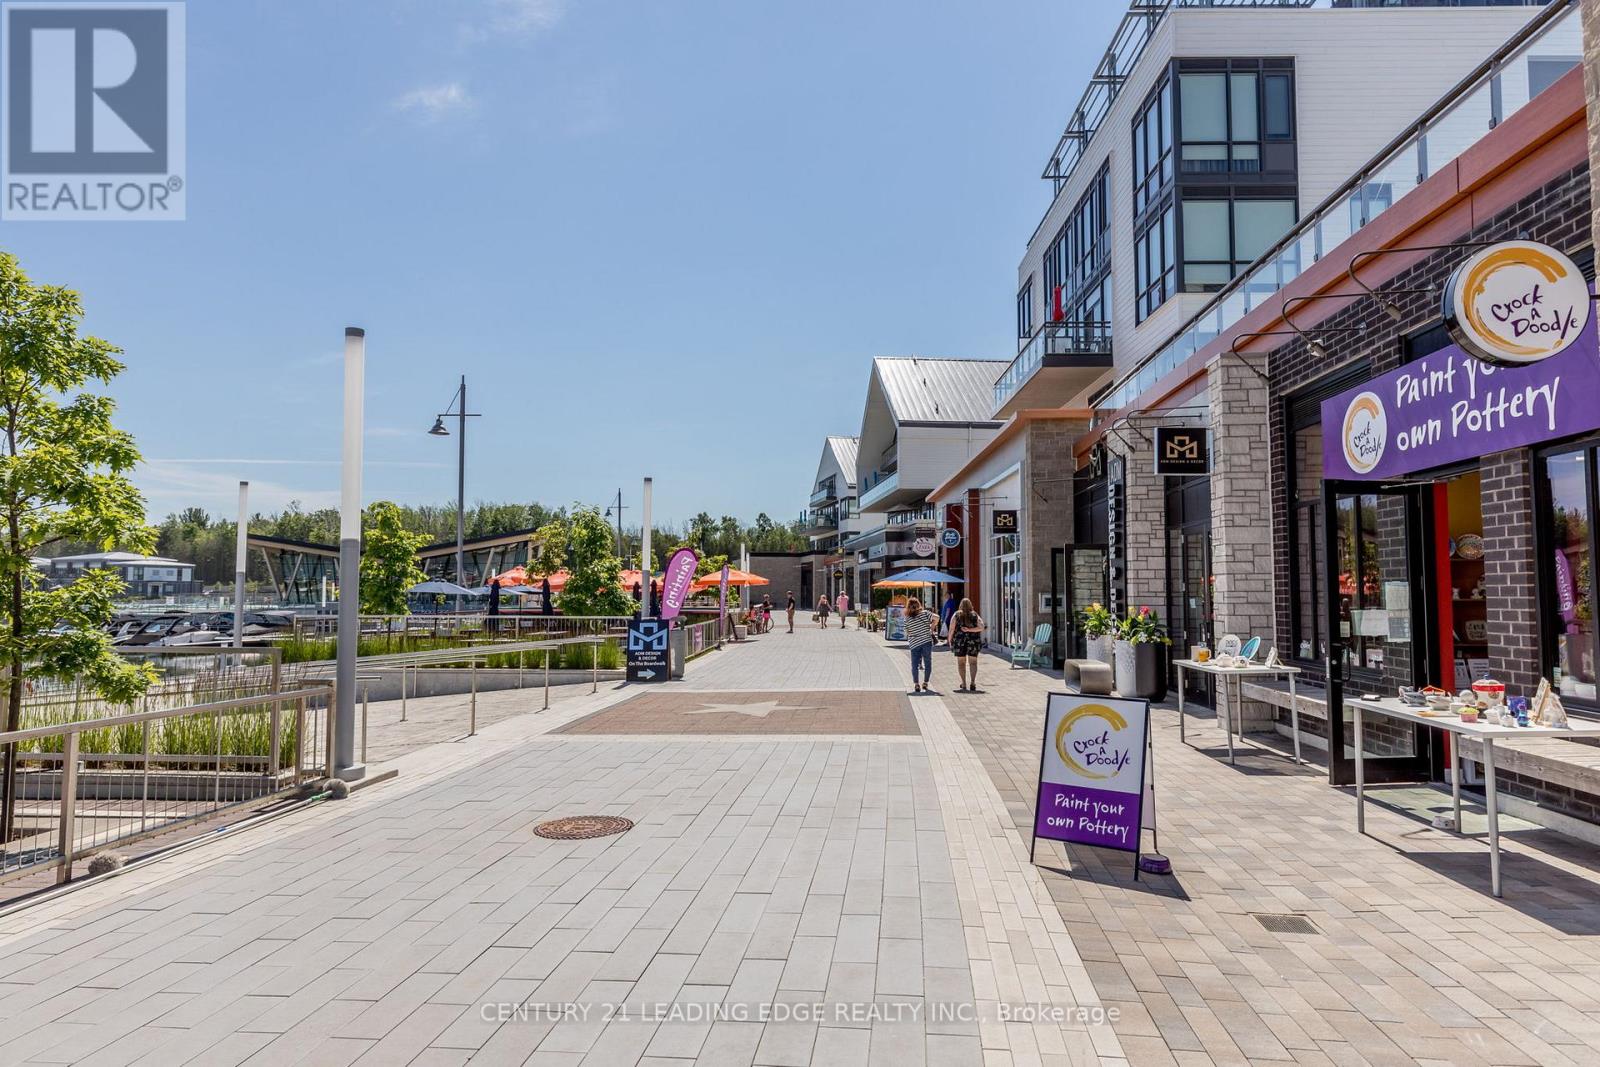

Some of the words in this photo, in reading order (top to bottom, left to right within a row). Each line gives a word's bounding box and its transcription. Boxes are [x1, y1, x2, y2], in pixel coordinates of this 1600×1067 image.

[1491, 284, 1543, 322] Crock
[1511, 305, 1578, 340] Doodle
[1396, 356, 1456, 408] Paint
[1396, 419, 1441, 451] own
[1451, 376, 1560, 438] Pottery
[1354, 421, 1371, 448] Crock
[1360, 434, 1382, 457] Doodle
[1074, 730, 1110, 754] Crock
[1086, 748, 1131, 771] Doodle
[1054, 794, 1089, 812] Paint
[1093, 800, 1125, 818] your
[1047, 817, 1074, 829] own
[1079, 816, 1129, 844] Pottery
